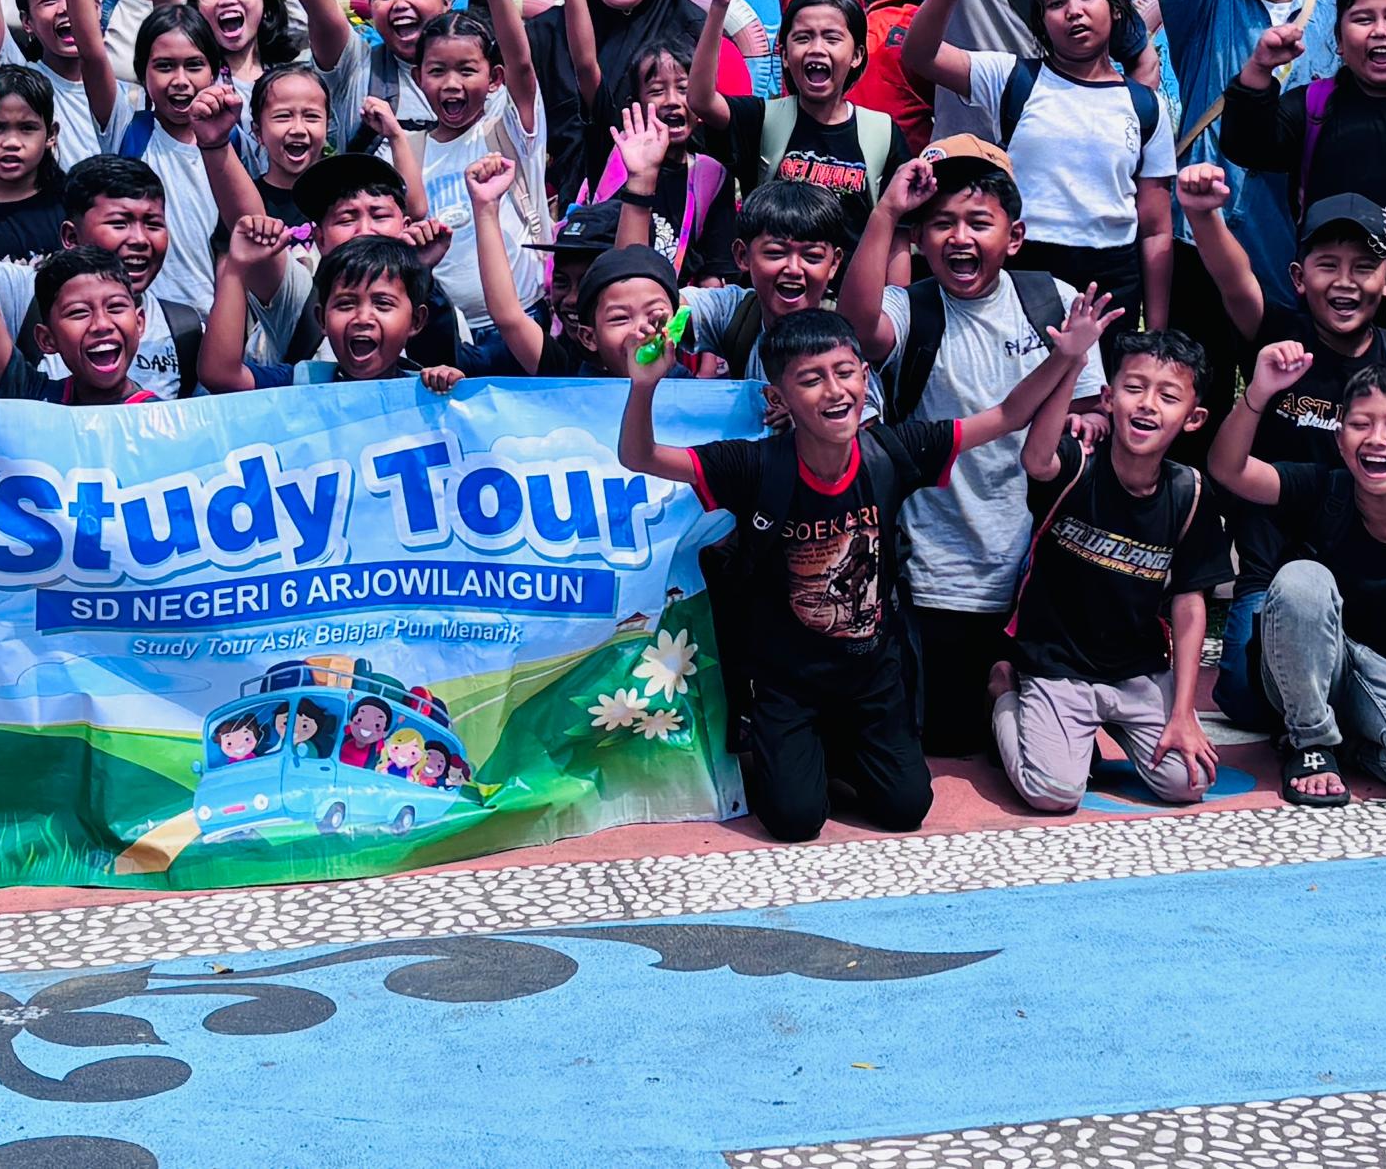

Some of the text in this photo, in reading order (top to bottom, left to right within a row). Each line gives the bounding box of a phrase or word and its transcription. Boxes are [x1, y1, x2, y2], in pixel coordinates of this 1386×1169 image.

[372, 441, 649, 549] Tour
[70, 567, 584, 622] SD NEGERI 6 ARJOWILANGUN
[132, 617, 523, 659] Study Tour Asik Belajar Pun Menarik
